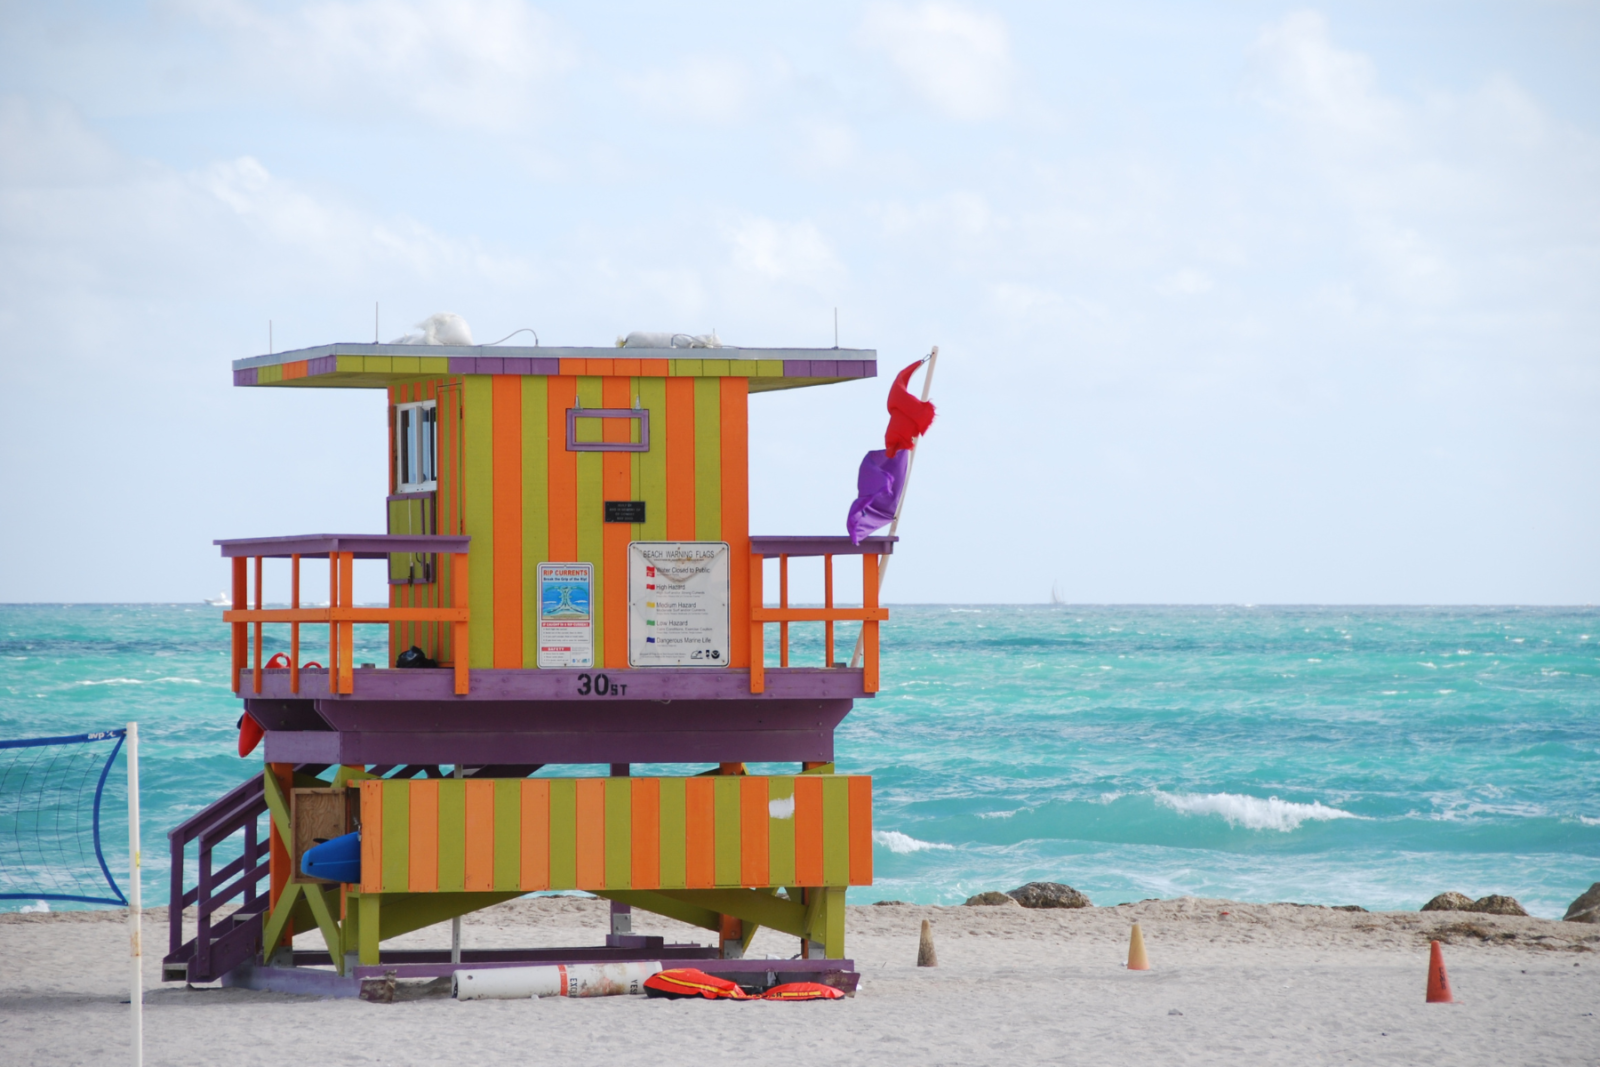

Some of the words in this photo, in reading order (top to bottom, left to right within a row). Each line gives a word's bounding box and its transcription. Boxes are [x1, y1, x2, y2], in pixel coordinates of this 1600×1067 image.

[643, 550, 663, 558] BEACH
[666, 550, 693, 558] WARNING
[695, 550, 715, 558] FLAGS
[656, 637, 683, 645] Dangerous
[88, 731, 105, 740] avp
